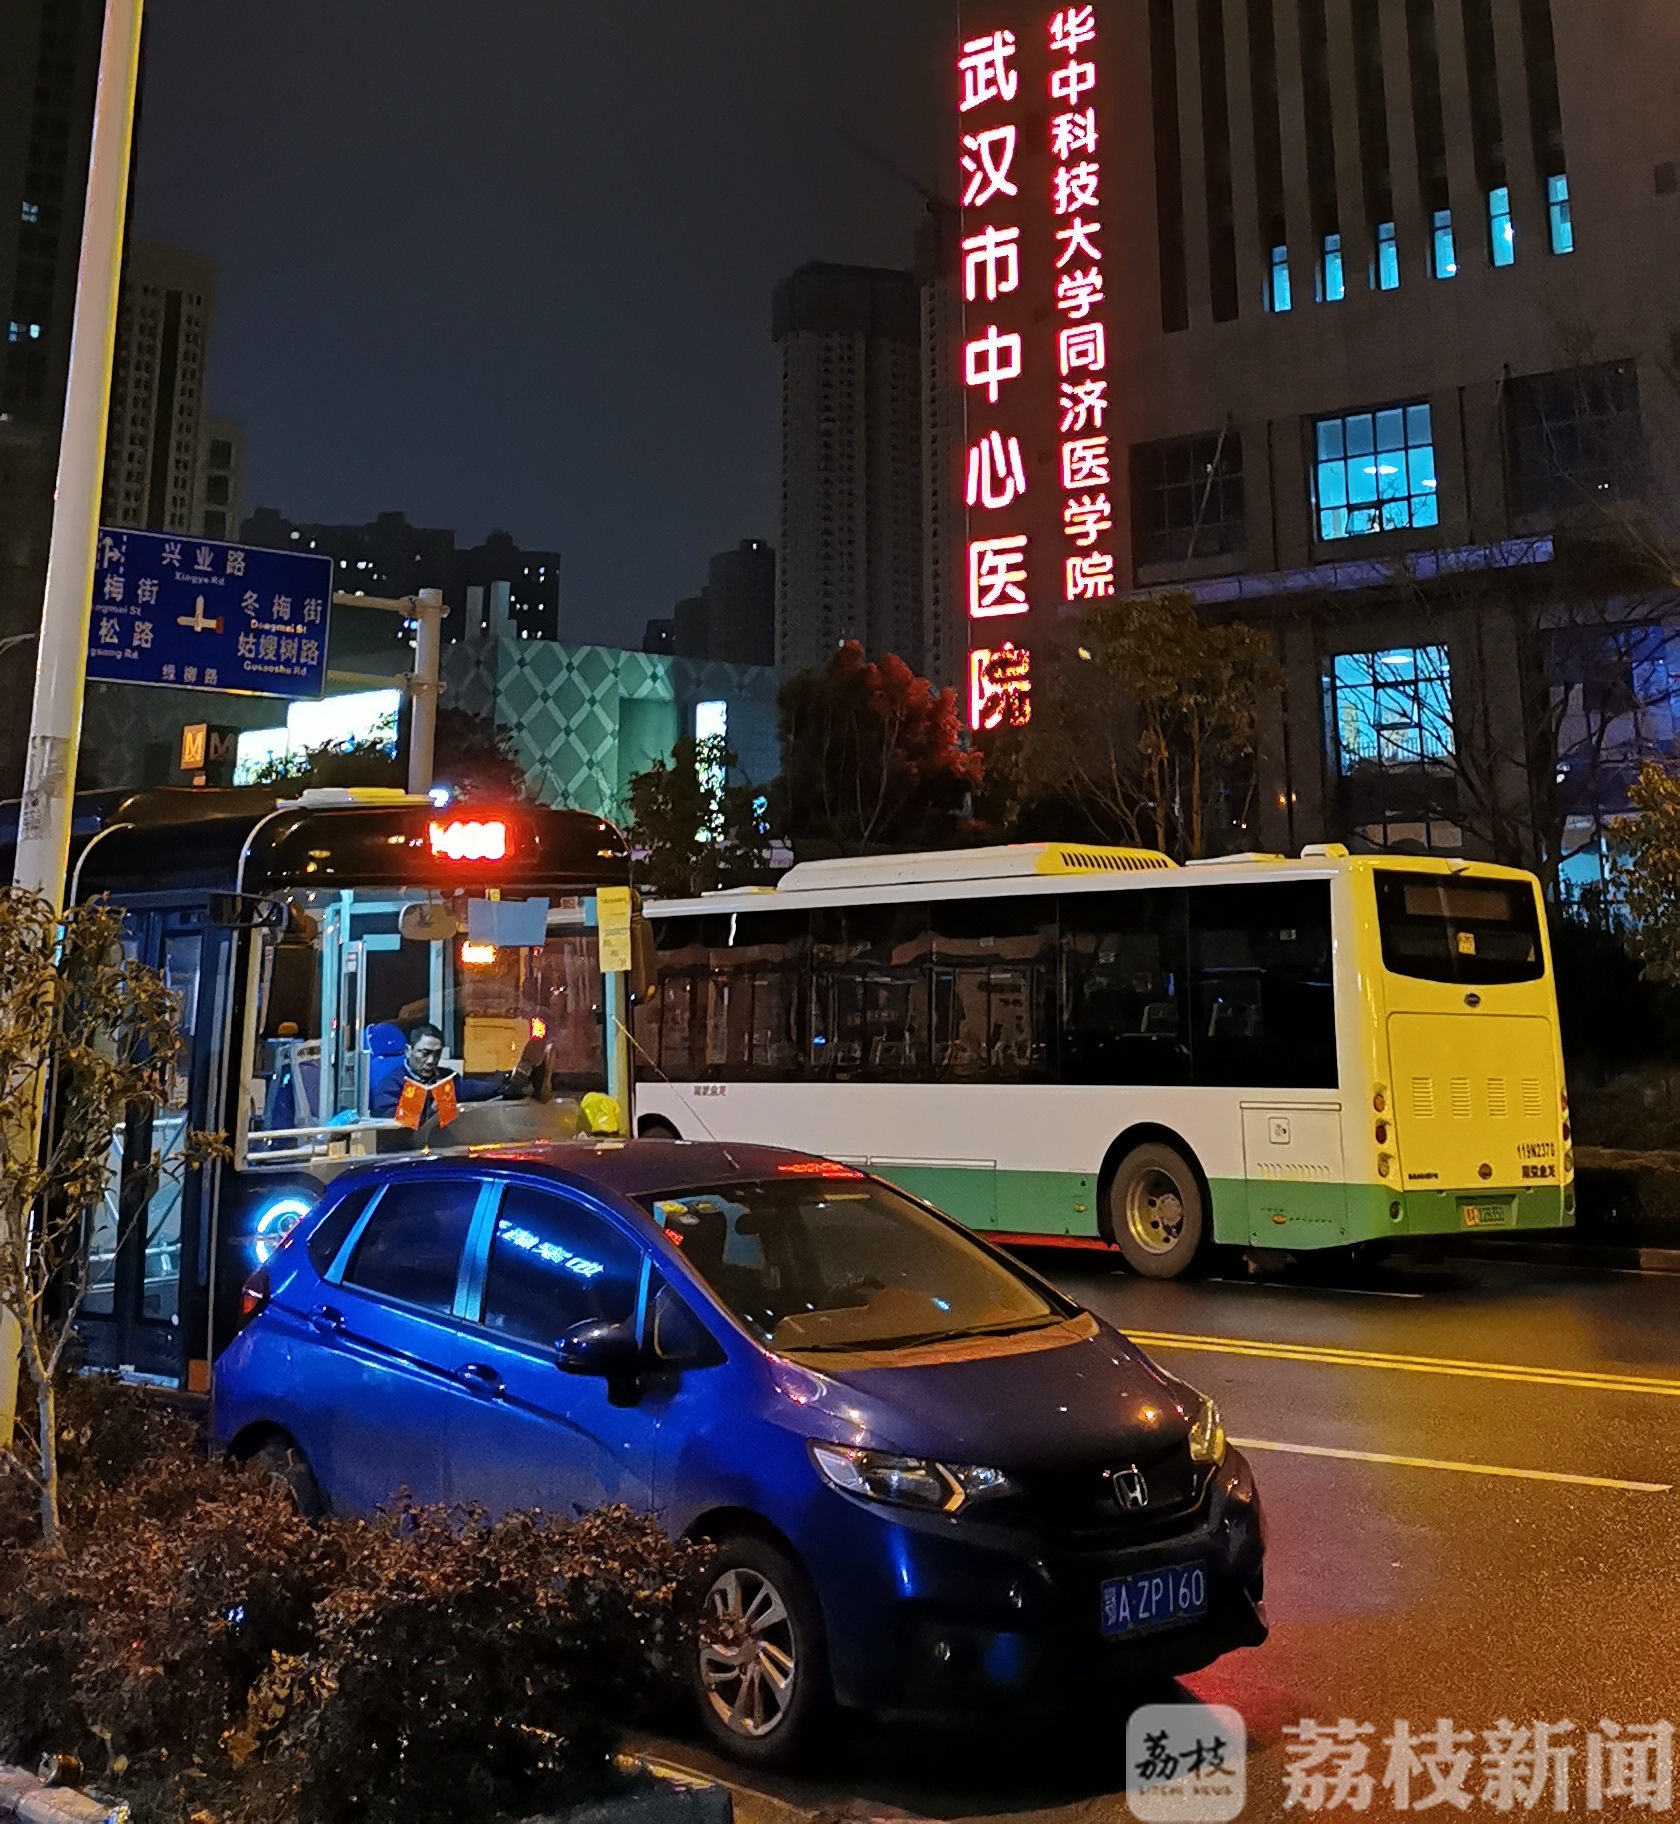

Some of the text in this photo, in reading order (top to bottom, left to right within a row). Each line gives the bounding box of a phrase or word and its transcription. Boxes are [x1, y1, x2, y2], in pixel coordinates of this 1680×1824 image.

[1050, 3, 1115, 602] 华中科技大学同济医学院
[958, 28, 1033, 732] 武汉市中心医院
[161, 541, 246, 577] 兴业路
[240, 589, 323, 625] 冬梅街
[237, 631, 320, 666] 姑嫂树路
